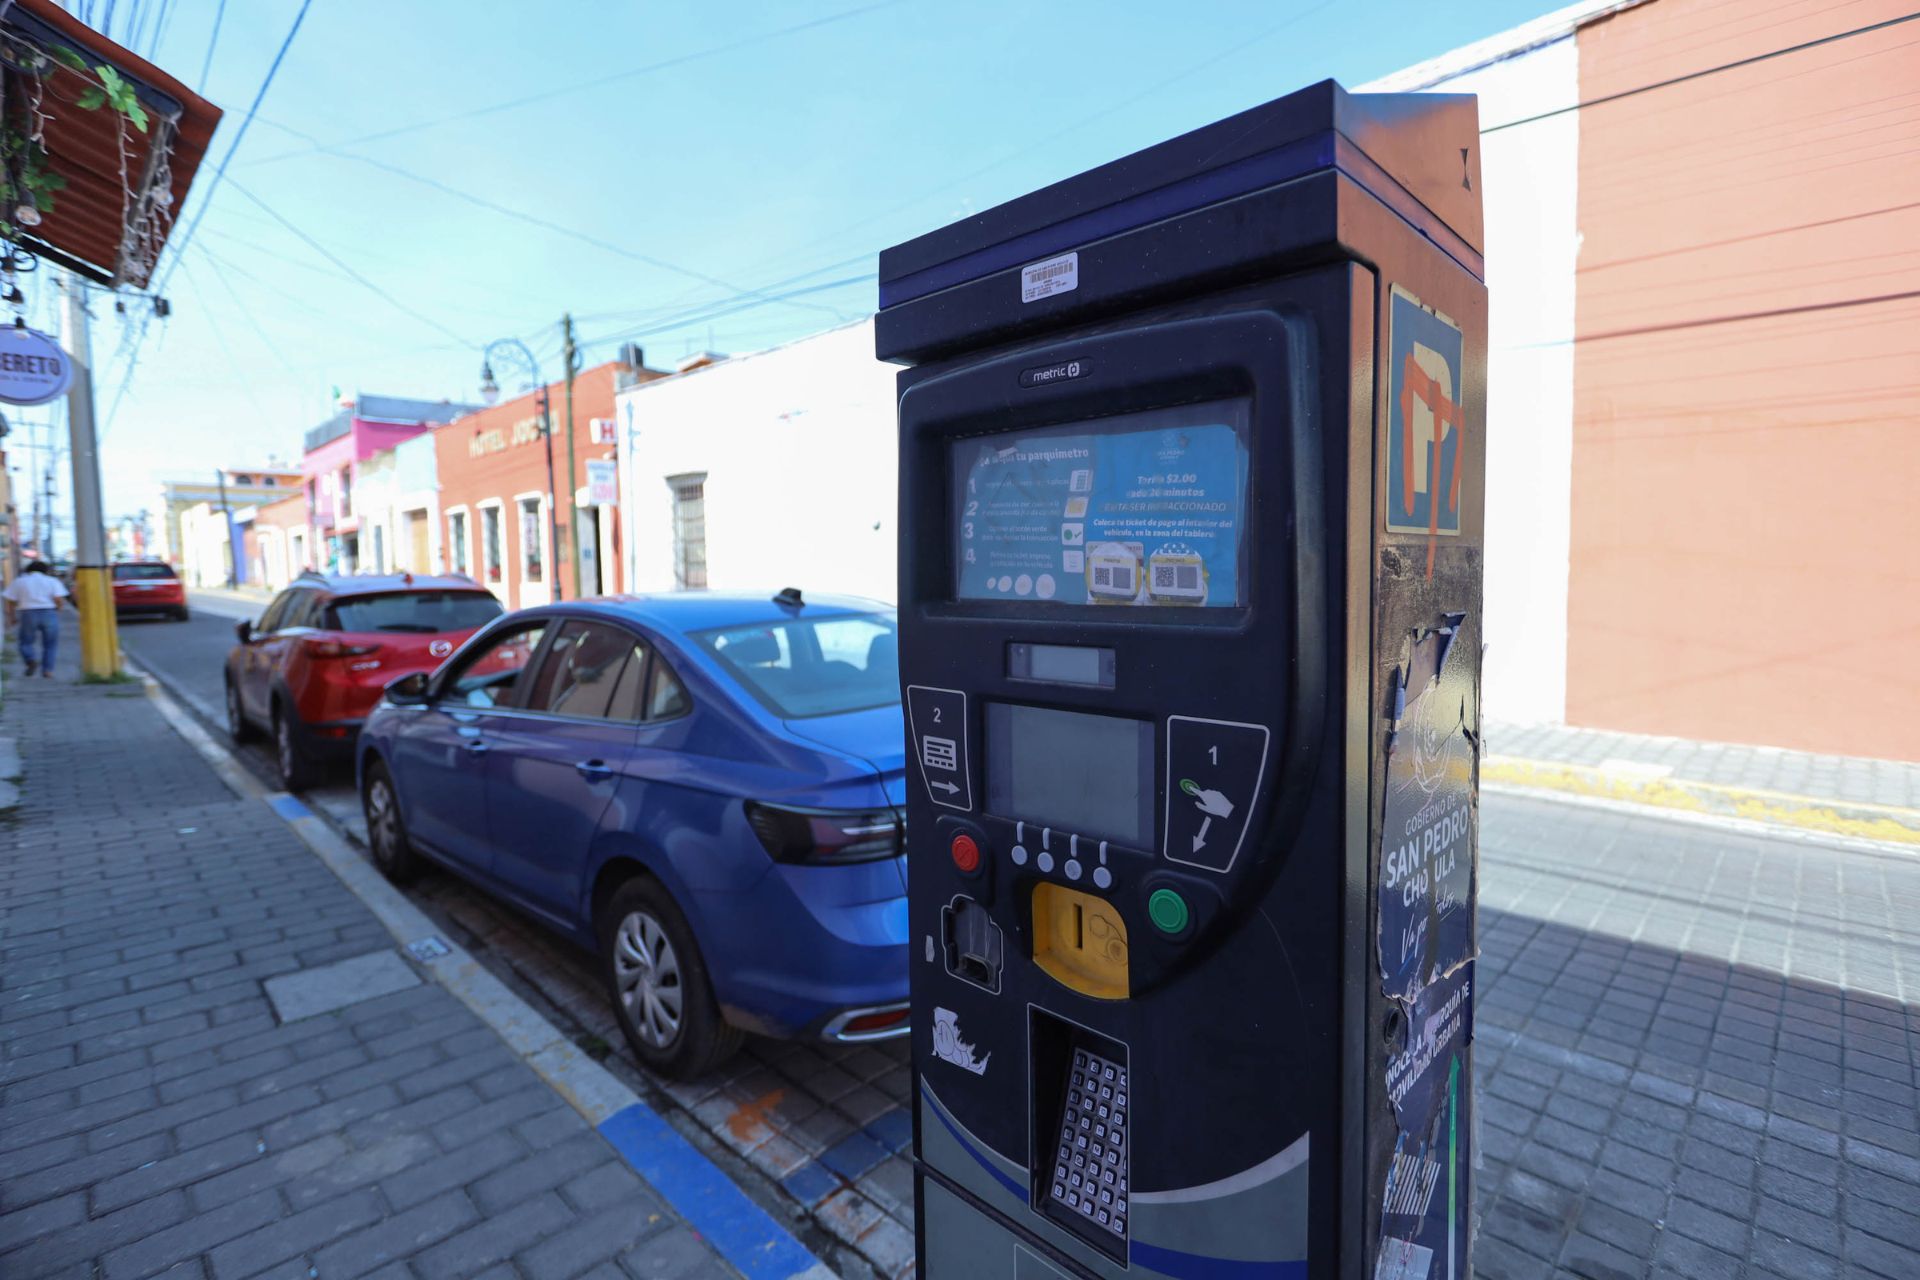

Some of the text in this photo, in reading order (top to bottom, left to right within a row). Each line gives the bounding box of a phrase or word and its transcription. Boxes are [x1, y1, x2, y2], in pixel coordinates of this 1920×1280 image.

[0, 352, 61, 376] ERETO
[1034, 367, 1066, 381] metric
[1412, 341, 1452, 493] P
[602, 421, 614, 439] H
[969, 477, 976, 493] 1
[1166, 473, 1197, 484] $2.00
[1163, 487, 1205, 497] minutos
[967, 501, 978, 516] 2
[1147, 502, 1227, 512] INACCIONADO
[965, 522, 974, 539] 3
[1126, 519, 1146, 527] ticket
[966, 548, 976, 564] 4
[933, 707, 942, 723] 2
[1208, 745, 1218, 765] 1
[1405, 800, 1446, 836] GOBIERNO
[1386, 805, 1468, 889] SAN PEDRO
[1403, 848, 1455, 907] CHOULA
